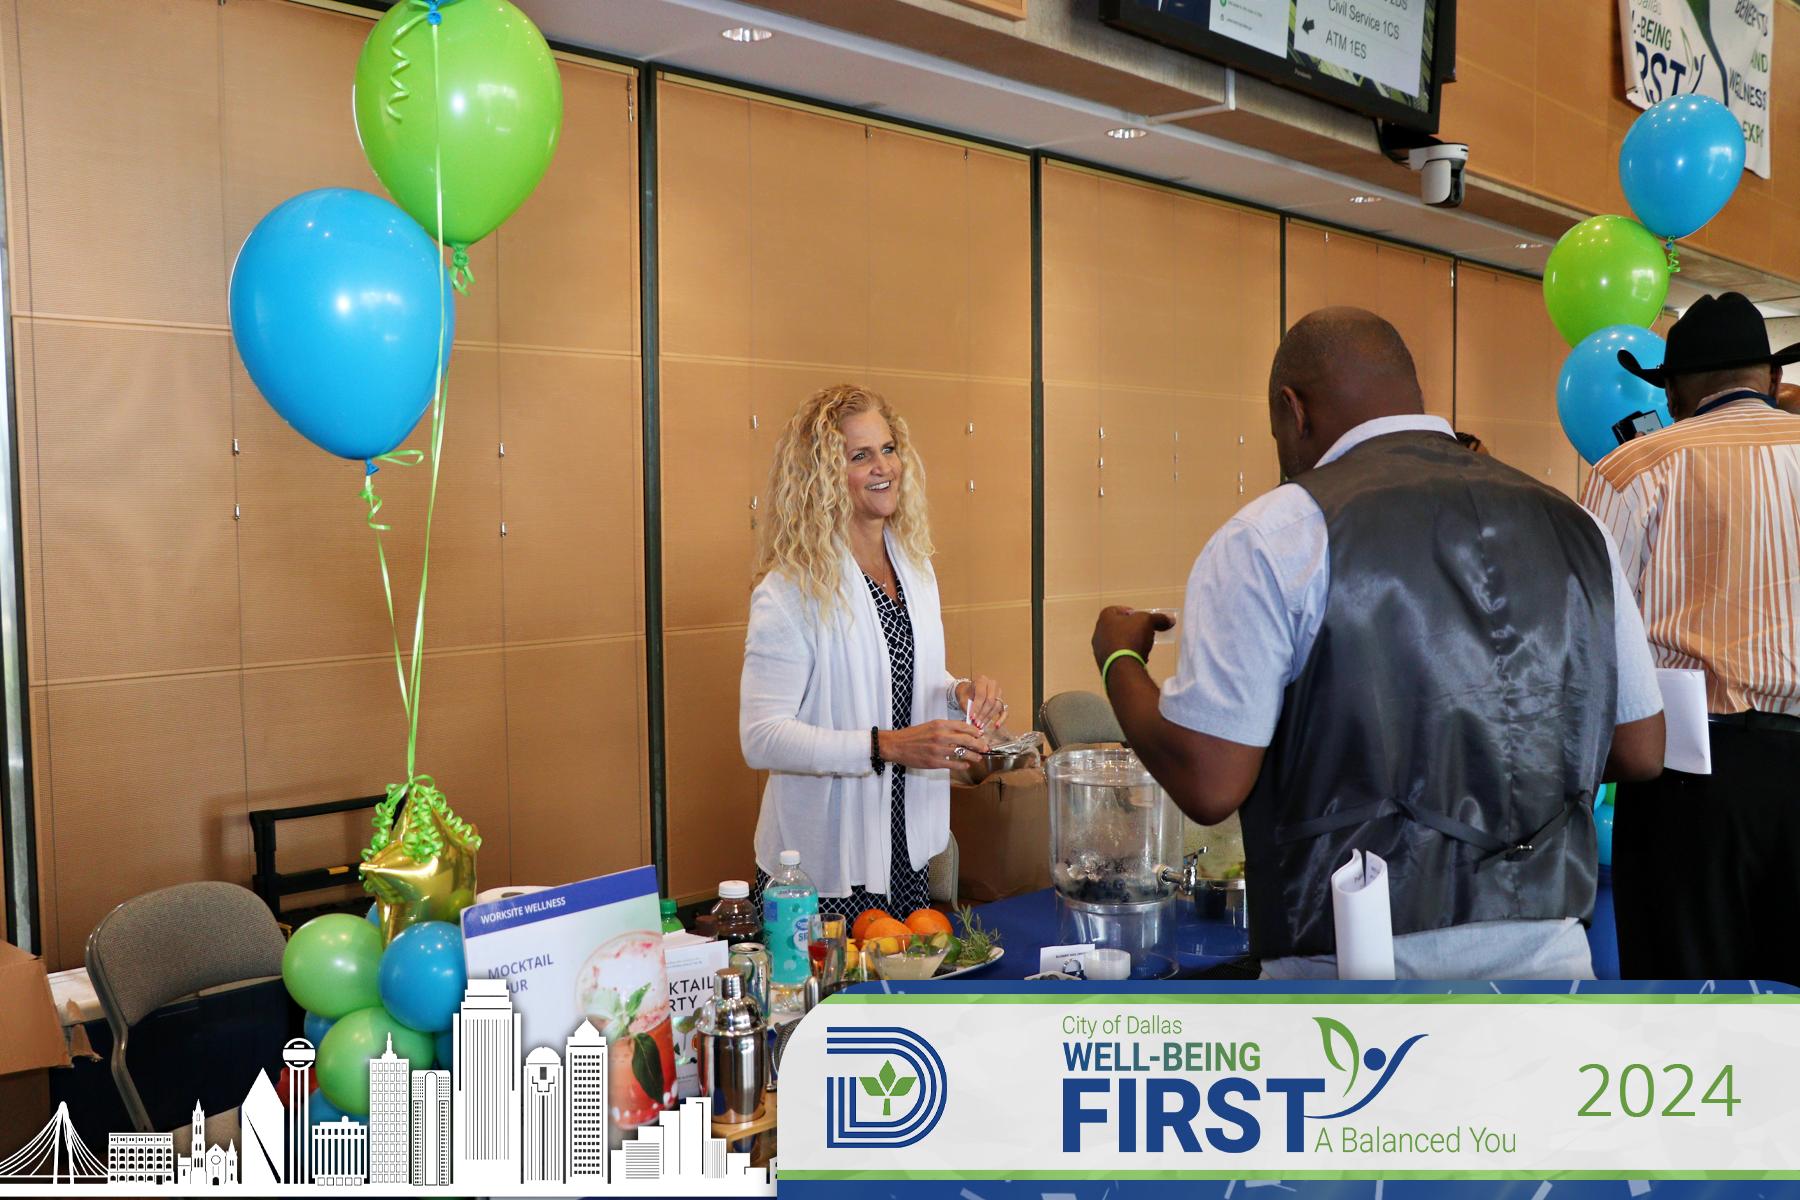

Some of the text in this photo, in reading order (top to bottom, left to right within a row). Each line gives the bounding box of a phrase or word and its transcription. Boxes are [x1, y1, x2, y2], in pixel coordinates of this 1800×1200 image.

[1328, 0, 1400, 40] Civil Service 1CS
[1325, 29, 1367, 60] ATM 1ES
[1750, 49, 1769, 73] AND
[480, 896, 567, 925] WORKSITE WELLNESS
[487, 953, 555, 980] MOCKTAIL
[669, 975, 714, 996] KTAIL
